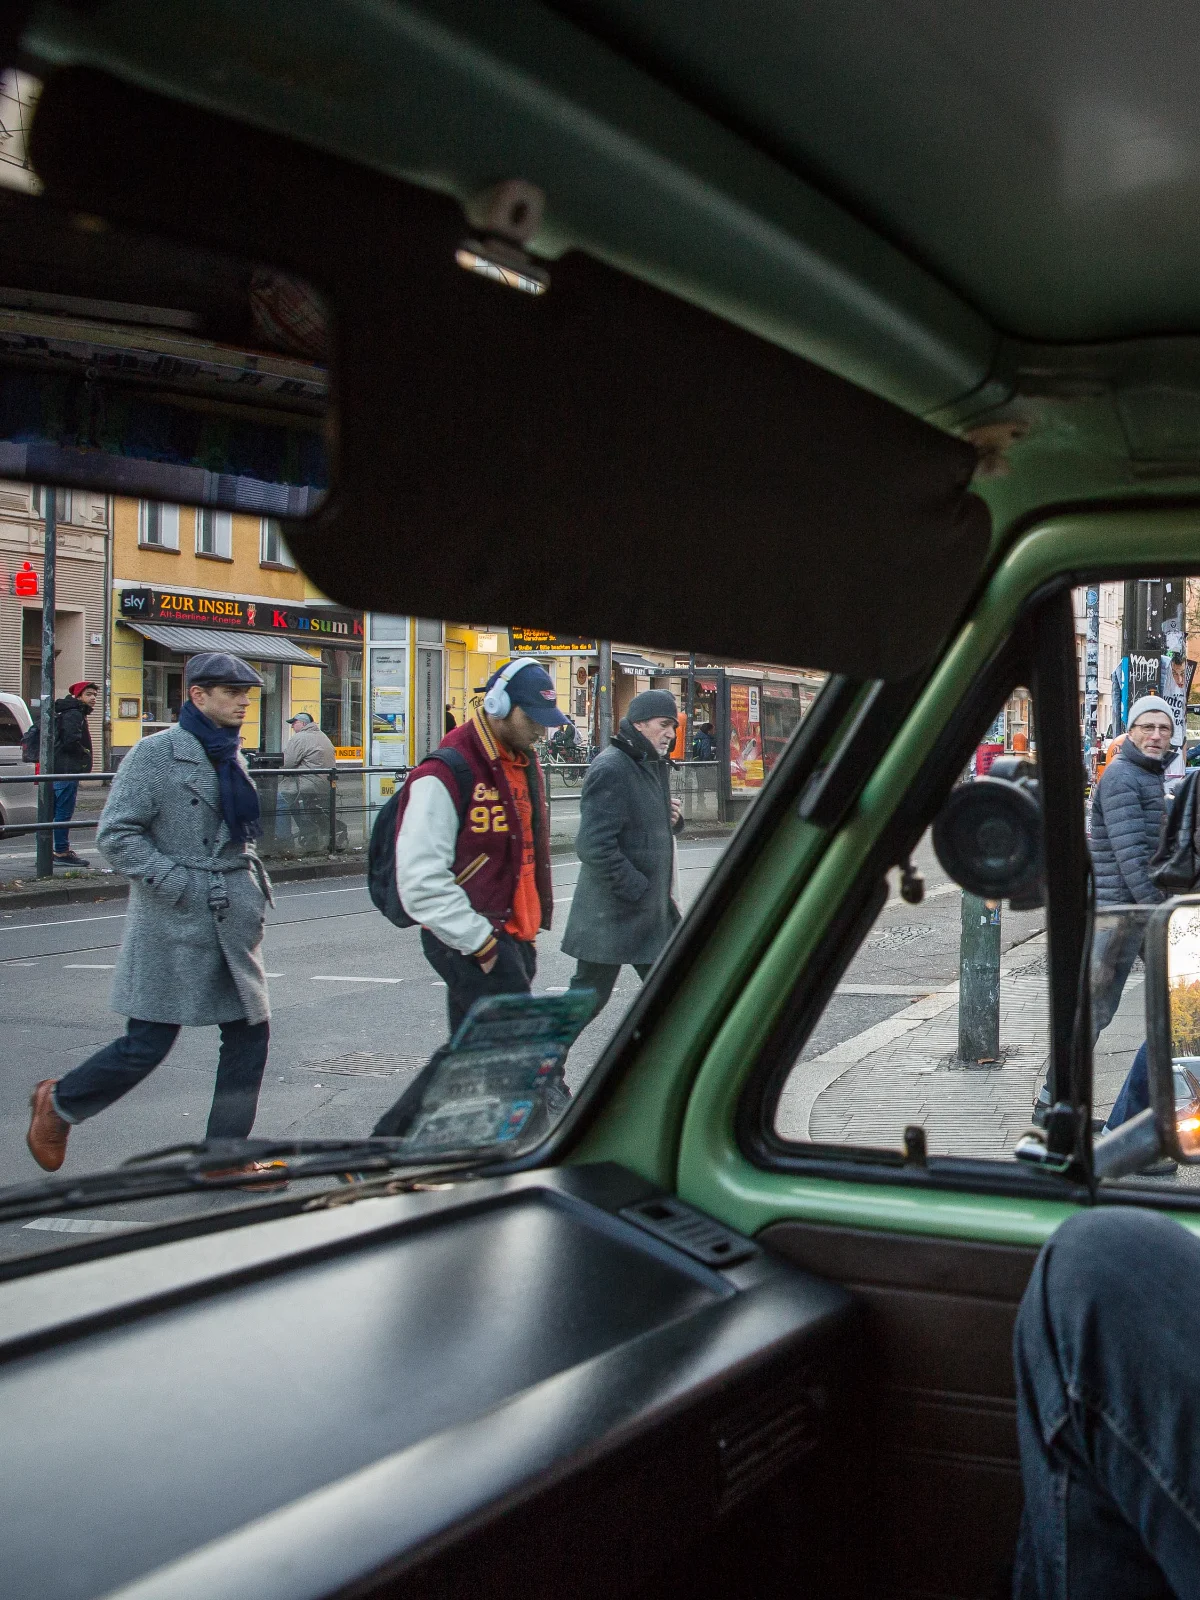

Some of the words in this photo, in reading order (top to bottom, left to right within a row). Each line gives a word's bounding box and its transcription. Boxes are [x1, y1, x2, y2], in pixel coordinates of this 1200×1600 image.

[123, 594, 146, 610] sky
[160, 594, 194, 612] ZUR
[198, 599, 243, 617] INSEL
[159, 610, 211, 623] Alt-Berliner
[212, 614, 242, 626] Kneipe
[272, 609, 349, 635] Konsum
[381, 786, 395, 795] BVG
[470, 805, 510, 833] 92
